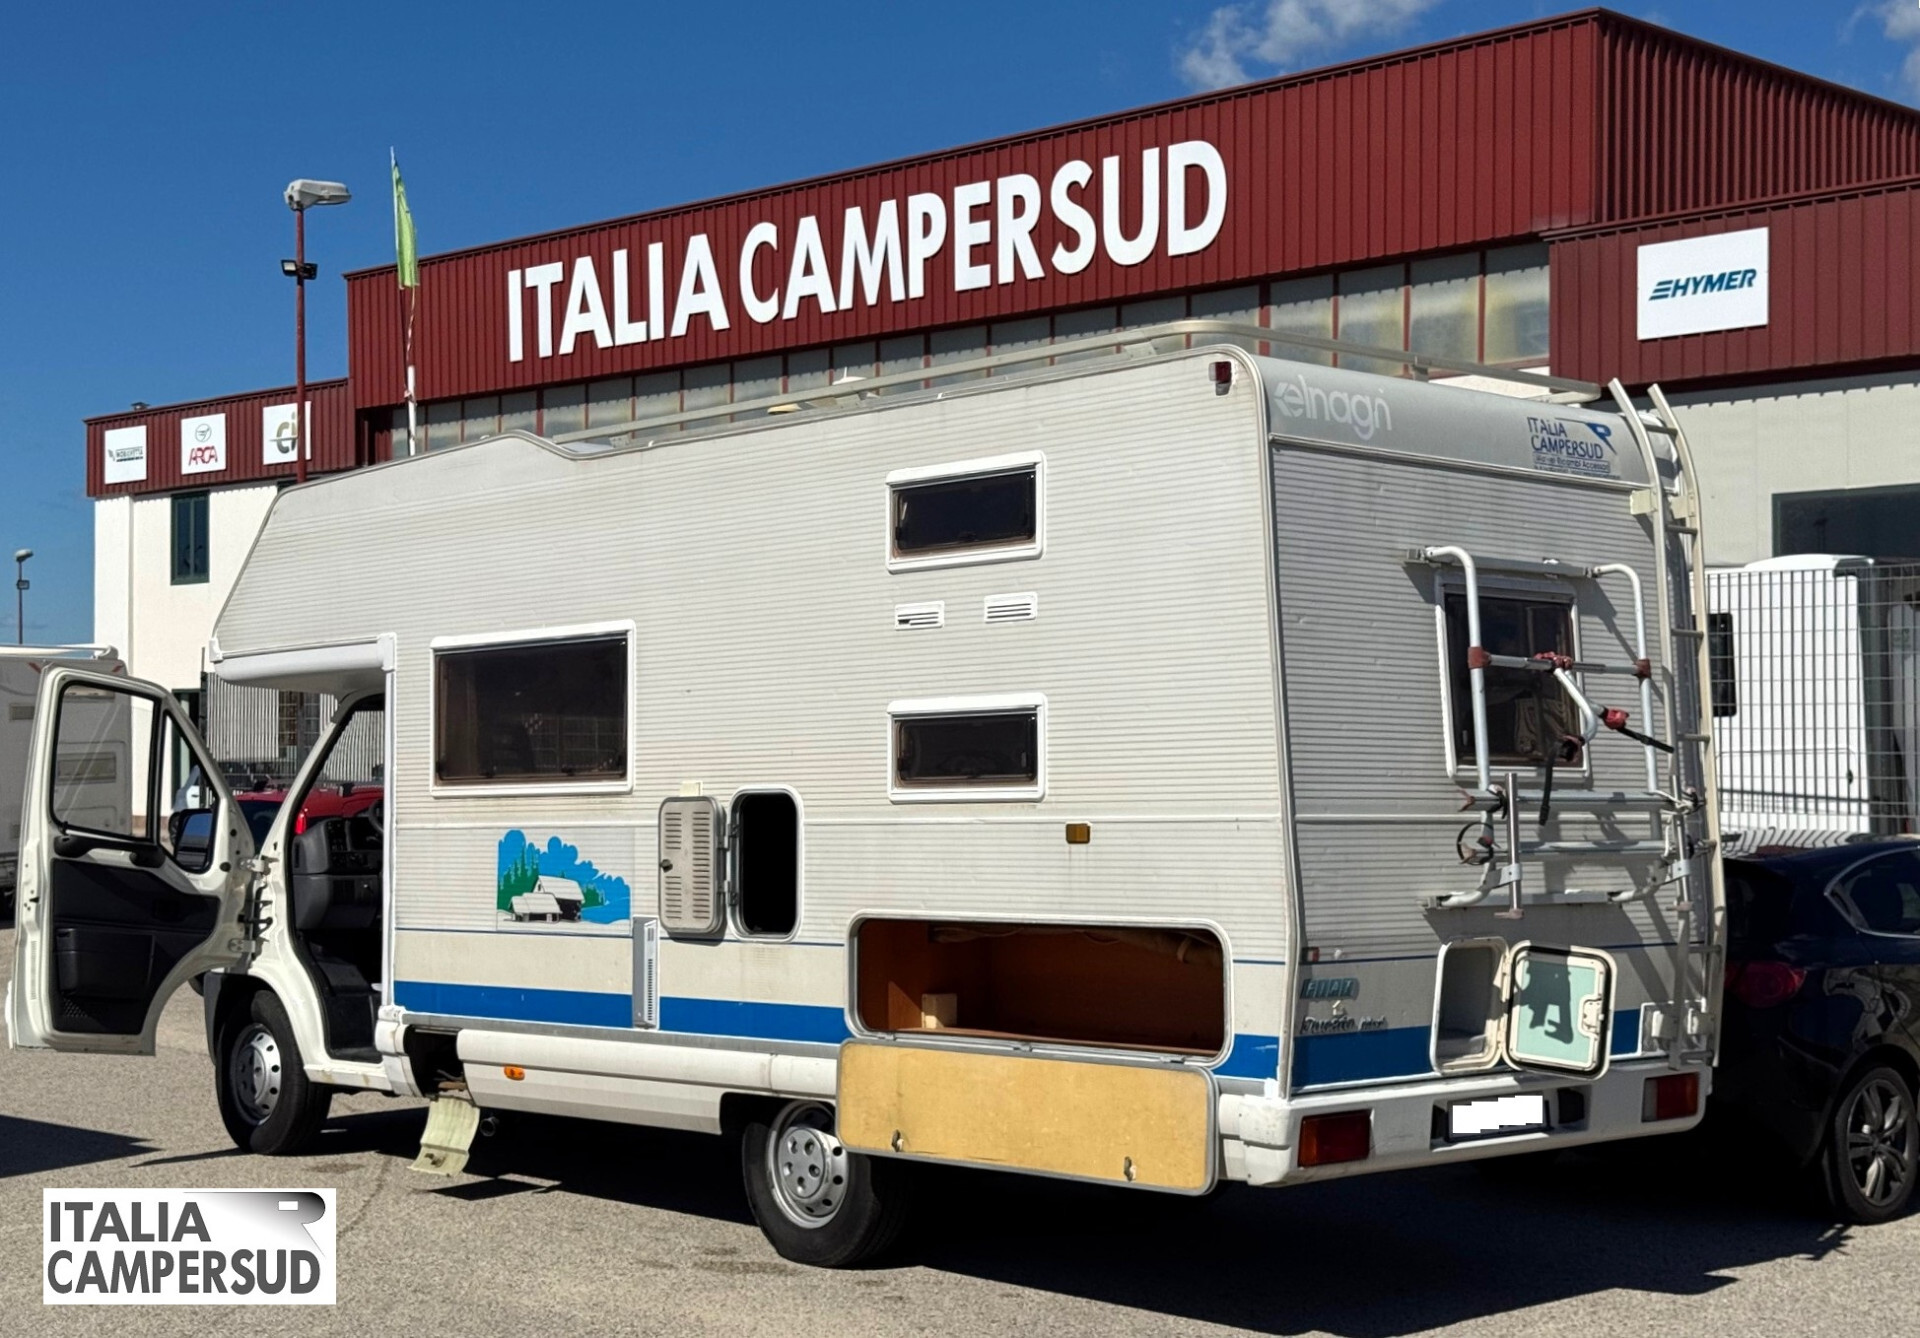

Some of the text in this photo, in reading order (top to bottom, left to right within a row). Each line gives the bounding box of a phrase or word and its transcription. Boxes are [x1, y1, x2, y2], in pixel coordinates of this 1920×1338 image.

[507, 139, 1227, 363] ITALIA CAMPERSUD
[1669, 268, 1758, 299] HYMER
[1527, 416, 1568, 438] ITALIA
[188, 446, 218, 466] ARCA
[1531, 435, 1604, 459] CAMPERSUD
[1306, 981, 1353, 997] FIAT
